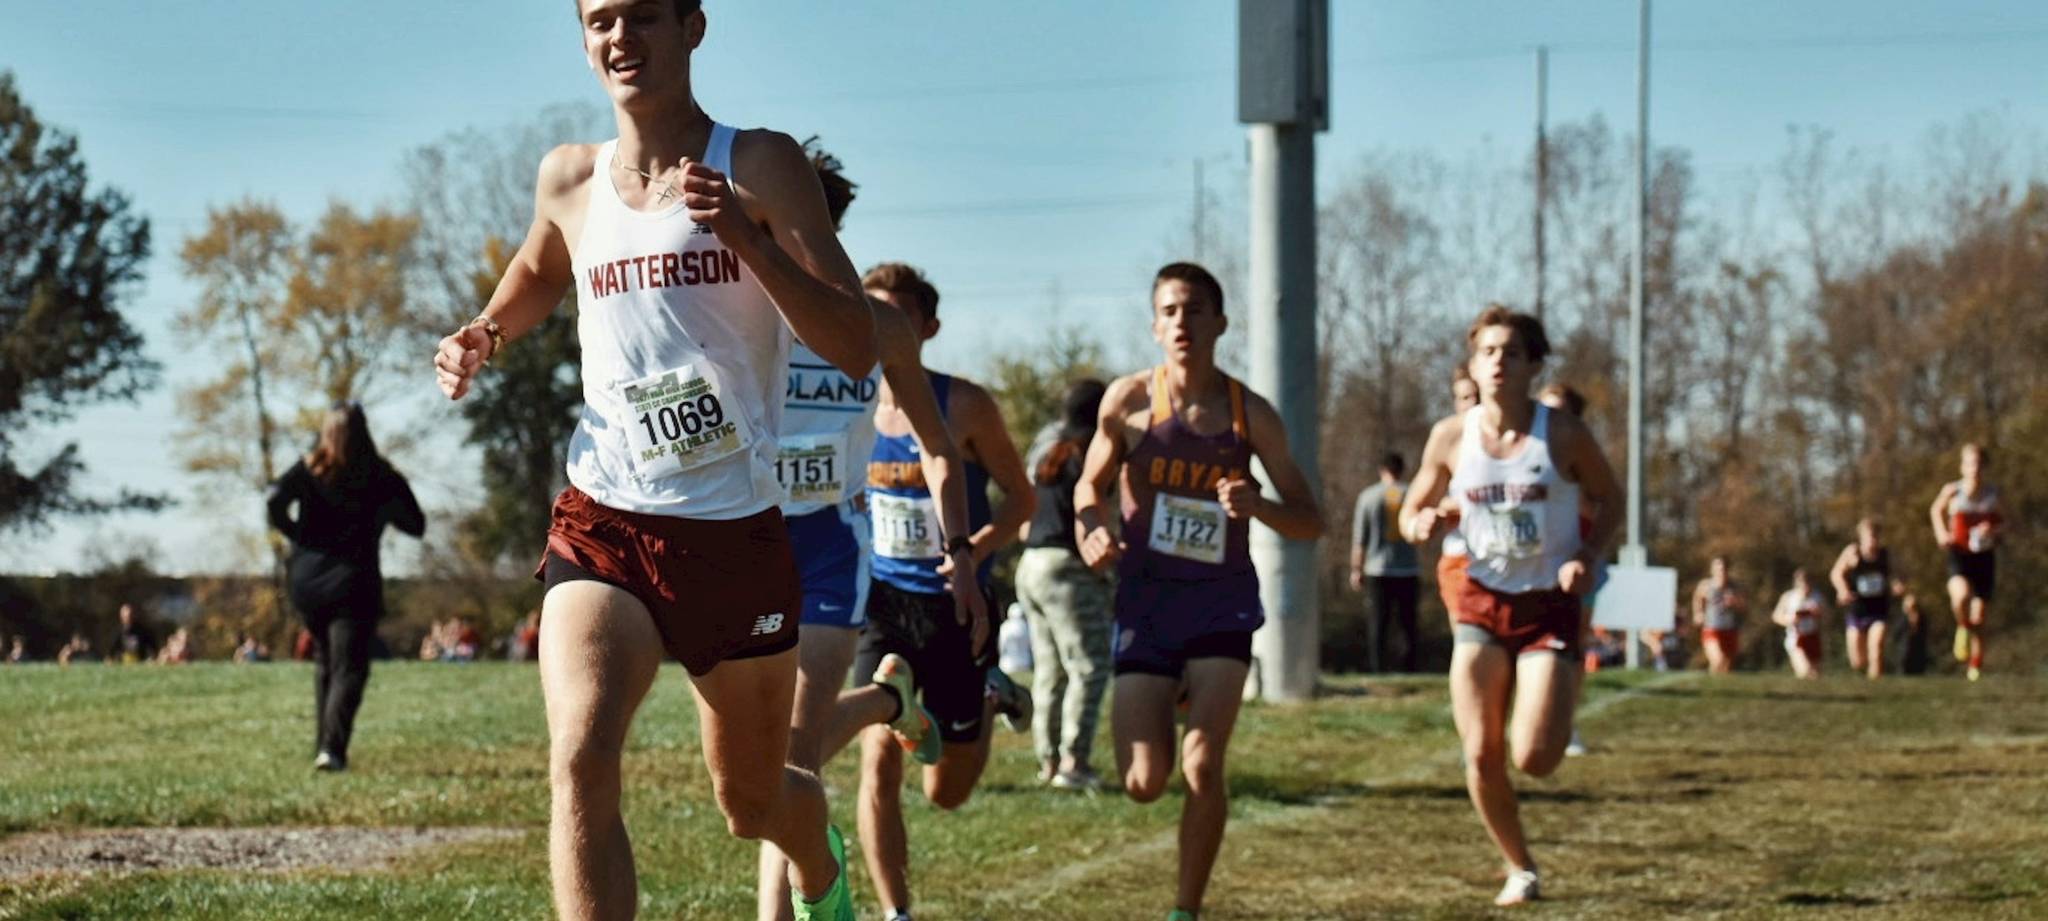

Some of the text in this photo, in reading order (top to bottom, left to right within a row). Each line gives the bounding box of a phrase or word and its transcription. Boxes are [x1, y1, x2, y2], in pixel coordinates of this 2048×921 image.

[588, 249, 740, 300] WATTERSON
[639, 393, 723, 445] 1069
[640, 422, 736, 462] M-F ATHLETIC
[774, 457, 833, 483] 1151
[882, 517, 927, 540] 1115
[1164, 516, 1218, 544] 1127
